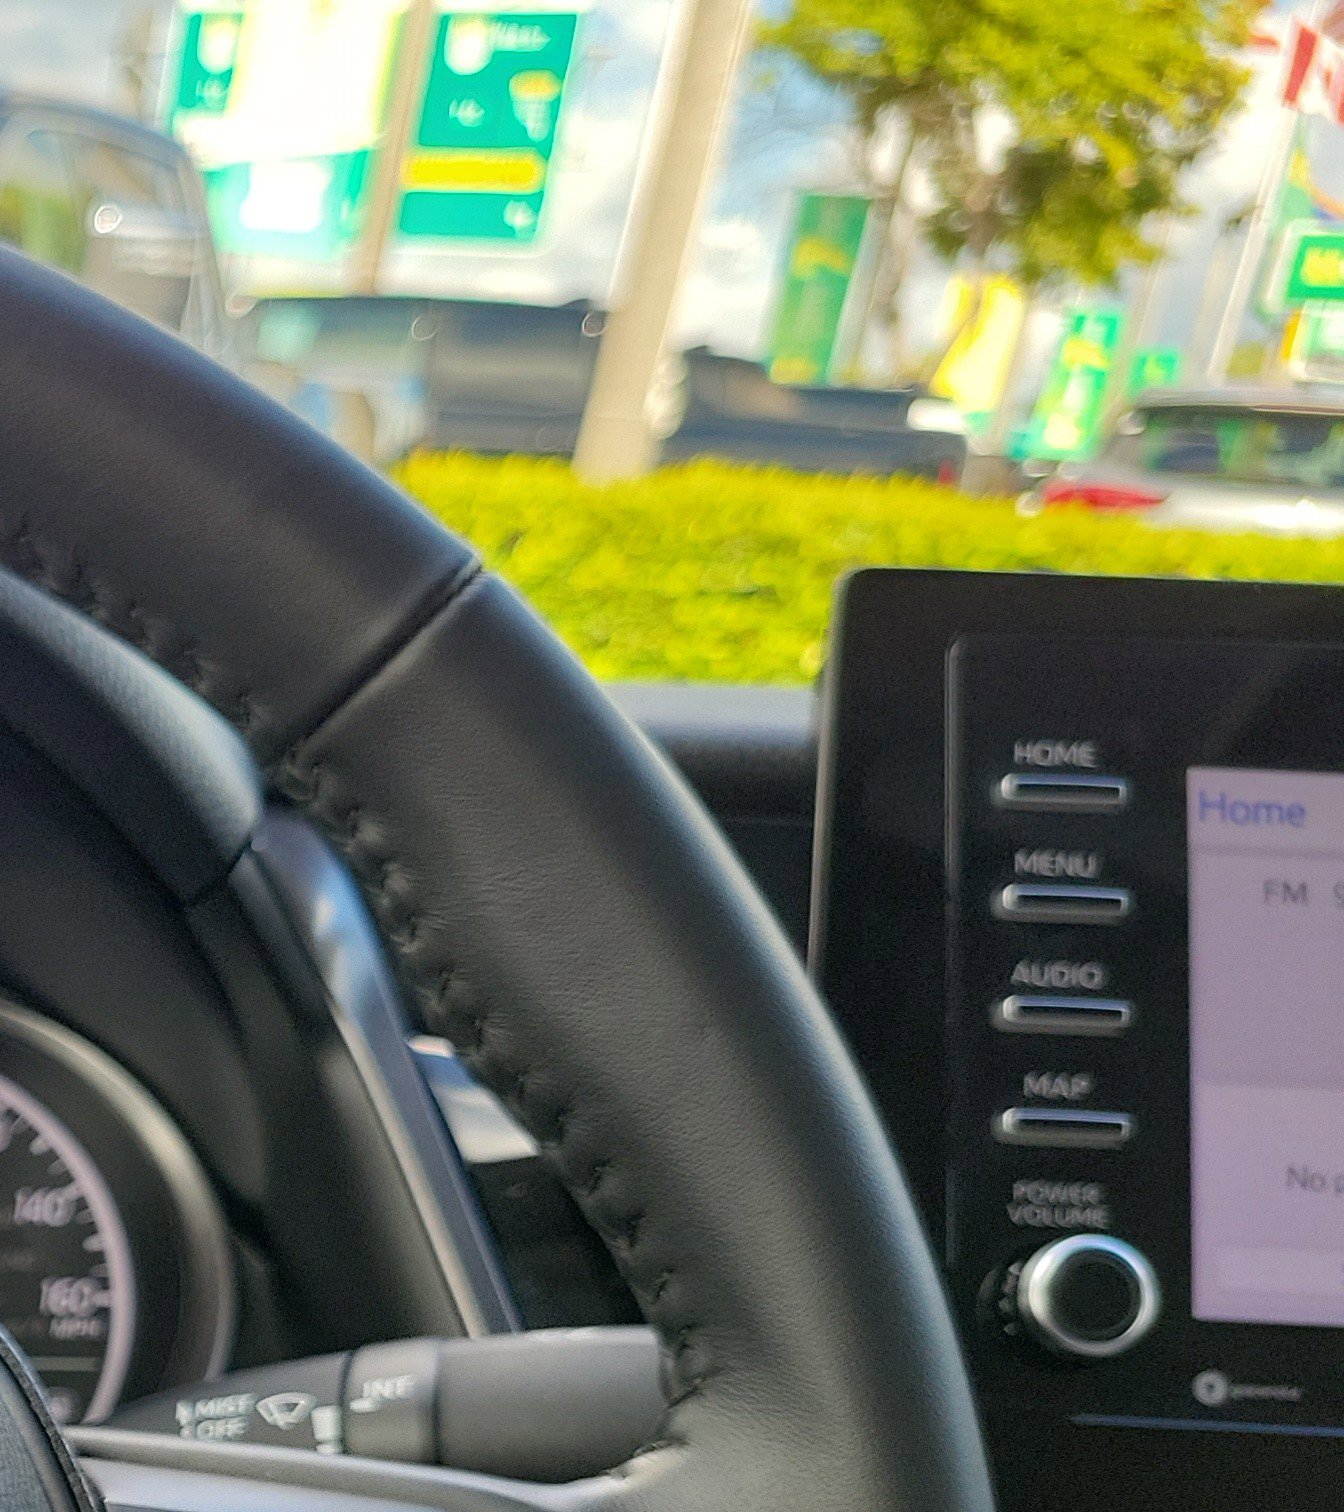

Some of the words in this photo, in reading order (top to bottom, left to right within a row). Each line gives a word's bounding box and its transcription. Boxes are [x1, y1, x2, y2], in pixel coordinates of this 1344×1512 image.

[1014, 740, 1097, 768] HOME
[1198, 789, 1306, 827] Home
[1014, 850, 1098, 878] MENU
[1263, 878, 1308, 905] FM
[1011, 959, 1105, 988] AUDIO
[1023, 1072, 1092, 1098] MAP
[1286, 1163, 1327, 1193] No
[15, 1188, 76, 1227] 140
[1006, 1202, 1111, 1228] VOLUME
[40, 1277, 97, 1317] 160
